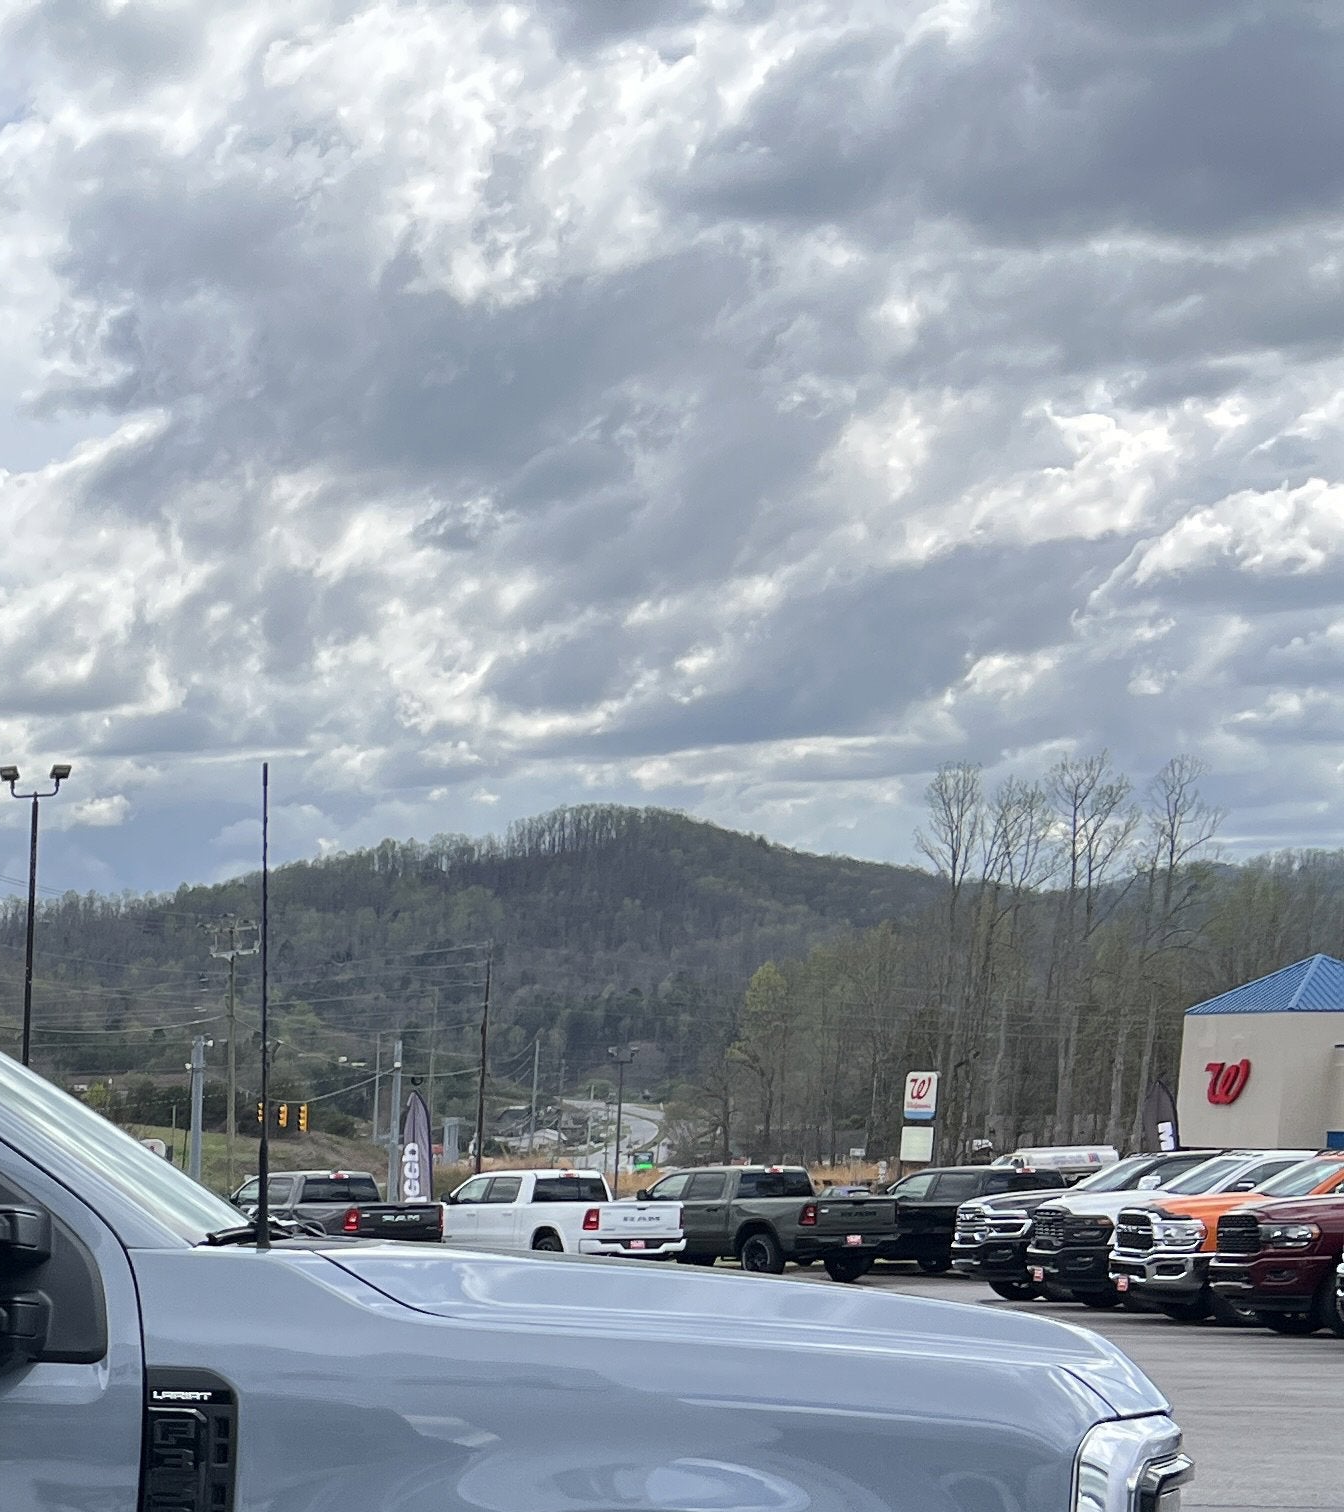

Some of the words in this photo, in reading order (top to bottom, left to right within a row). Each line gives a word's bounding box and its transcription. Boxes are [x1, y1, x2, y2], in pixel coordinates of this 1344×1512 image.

[1205, 1059, 1251, 1105] W
[382, 1214, 420, 1222] RAM
[152, 1390, 212, 1401] LARIAT
